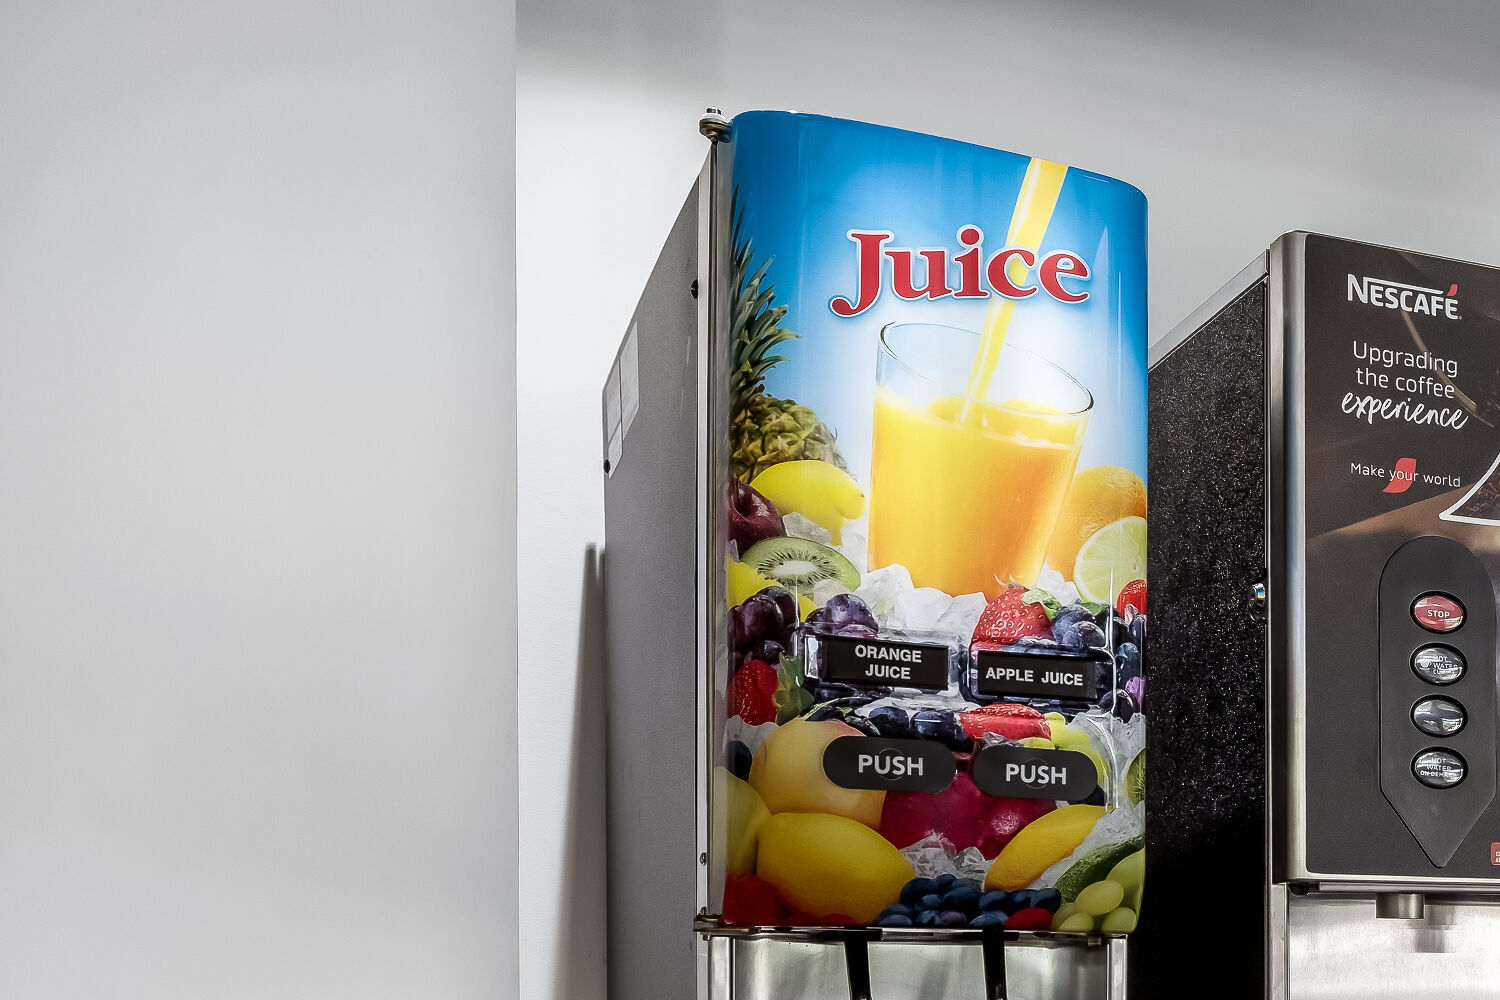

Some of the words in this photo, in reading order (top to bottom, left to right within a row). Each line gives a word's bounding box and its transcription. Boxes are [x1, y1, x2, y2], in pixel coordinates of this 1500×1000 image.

[829, 224, 1092, 318] Juice
[1353, 340, 1459, 378] Upgrading
[1356, 367, 1389, 389] the
[1395, 375, 1456, 399] coffee
[1341, 391, 1470, 430] experience
[1350, 462, 1385, 478] Make
[1389, 469, 1419, 483] your
[1423, 472, 1461, 488] world
[1427, 609, 1450, 619] STOP
[854, 644, 923, 664] ORANGE
[865, 663, 912, 680] JUICE
[985, 666, 1034, 683] APPLE
[1041, 670, 1084, 686] JUICE
[858, 754, 924, 777] PUSH
[1005, 763, 1068, 786] PUSH
